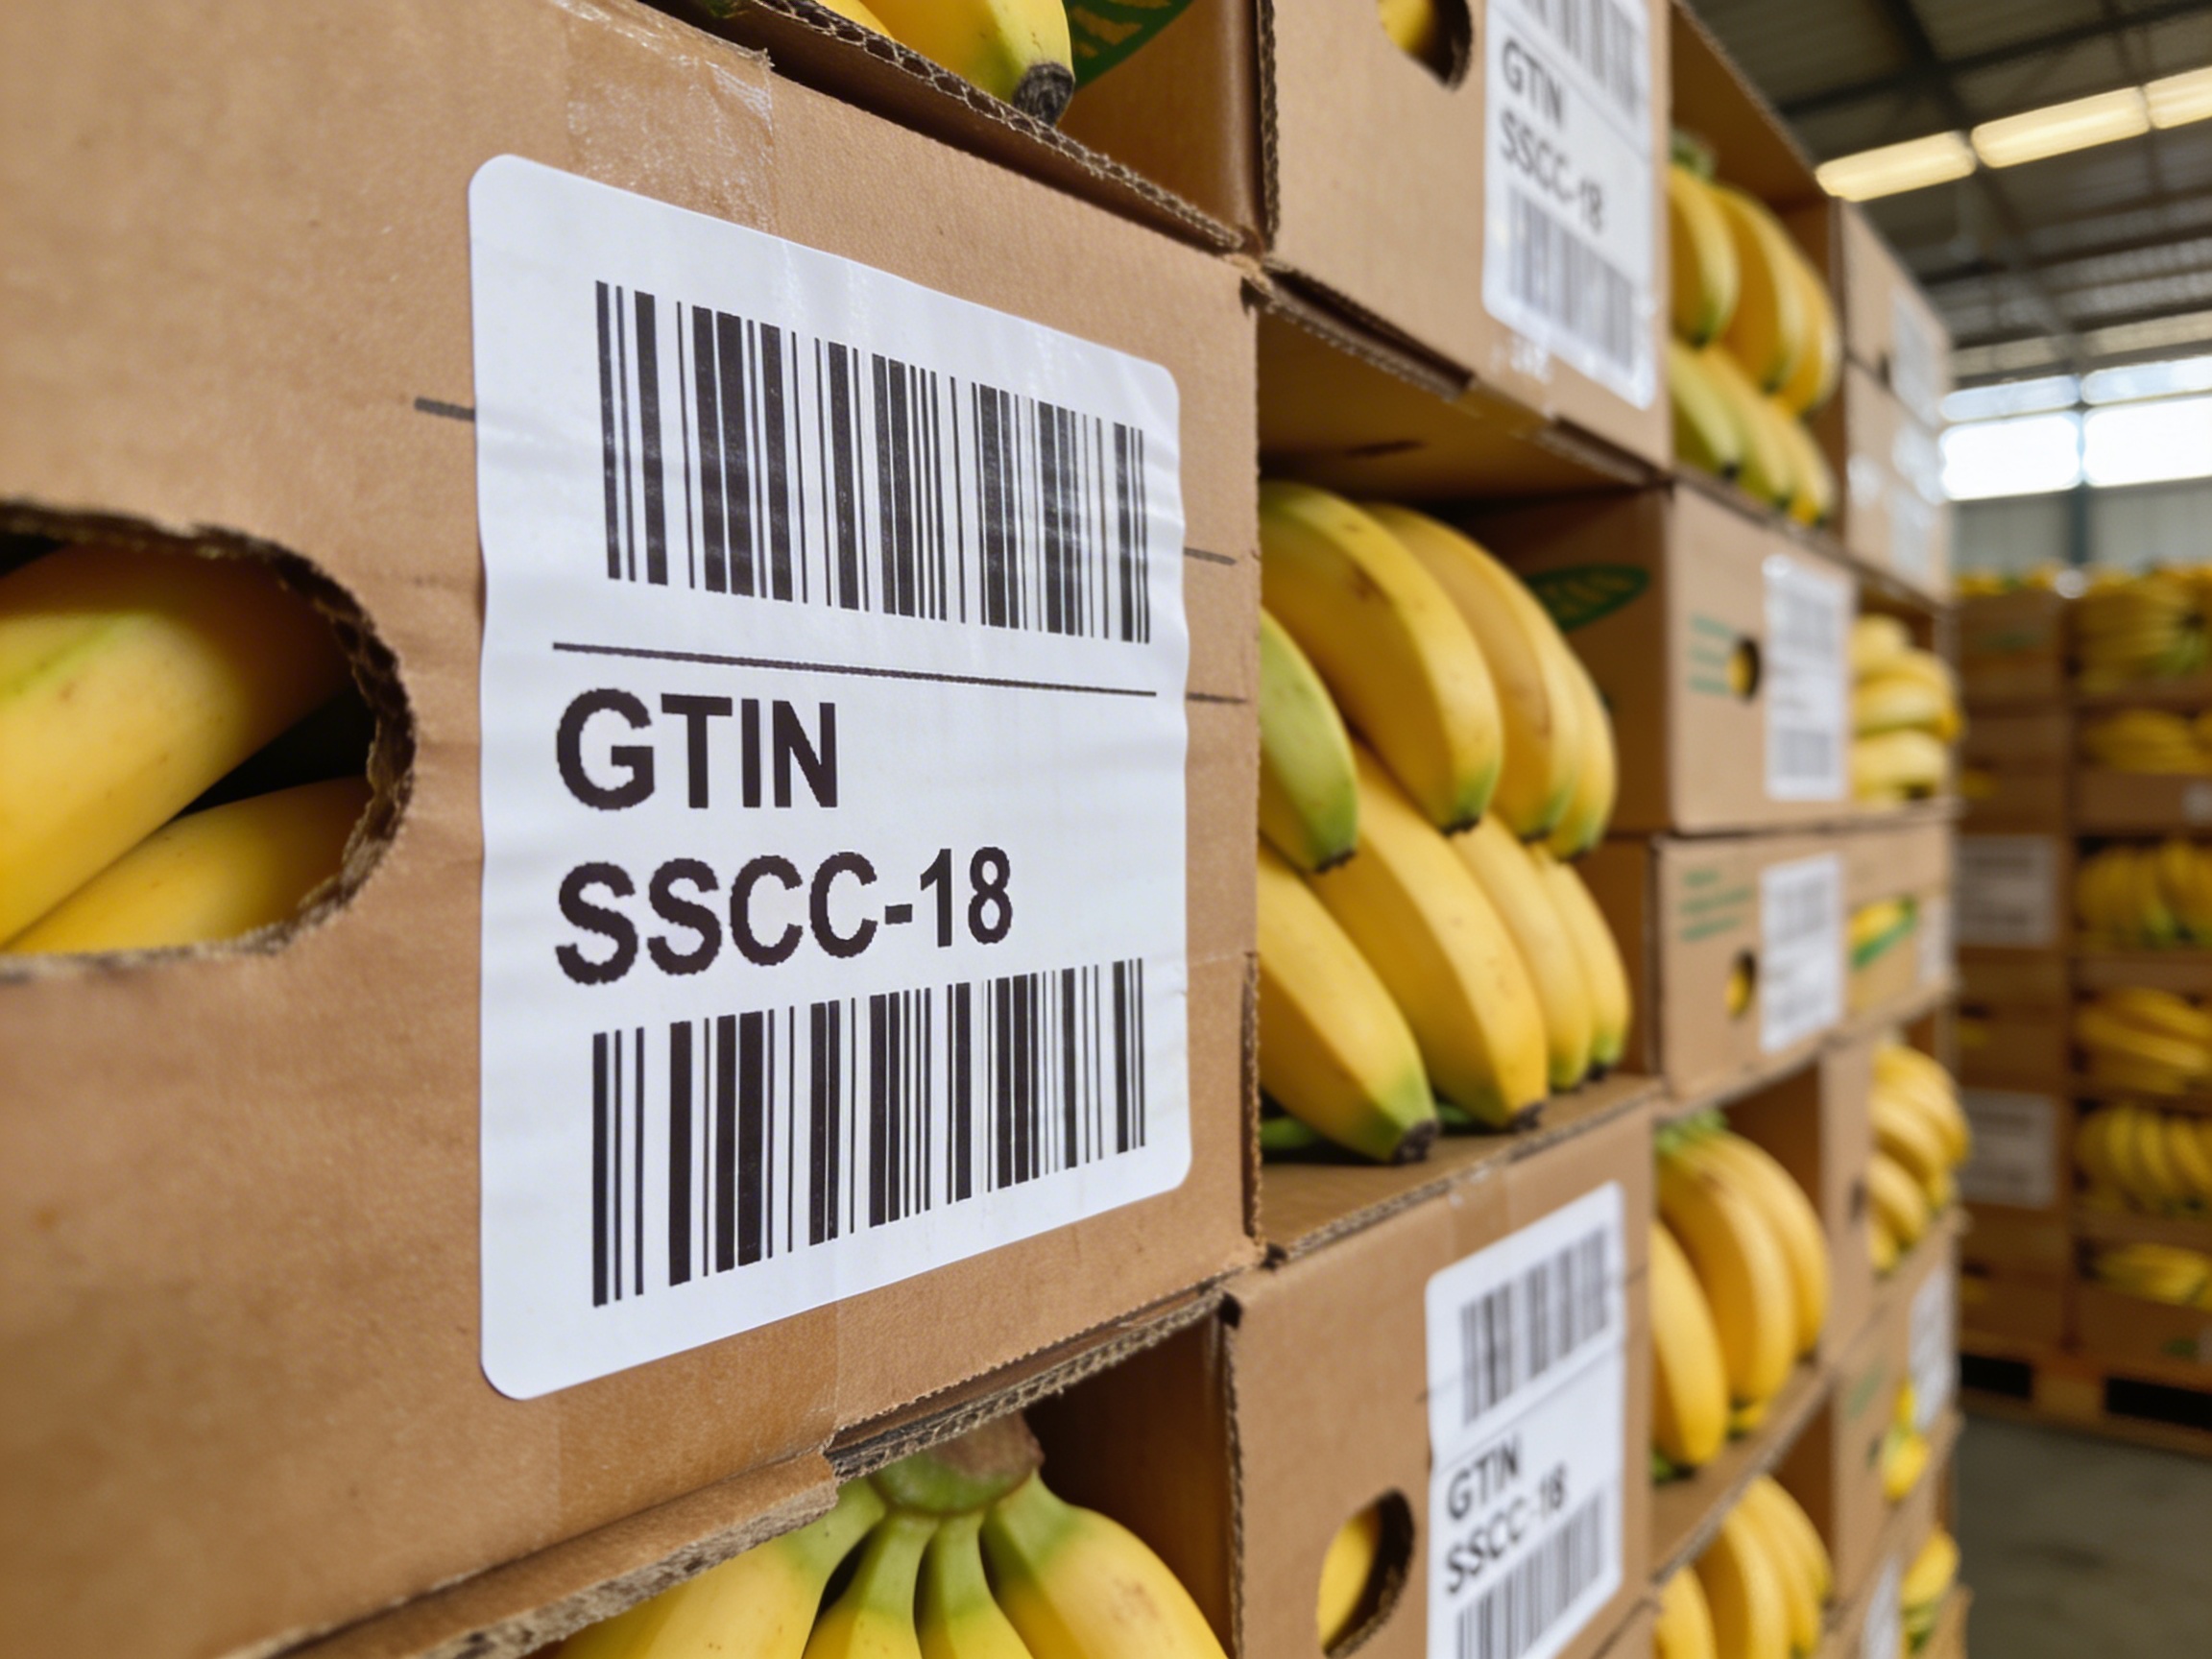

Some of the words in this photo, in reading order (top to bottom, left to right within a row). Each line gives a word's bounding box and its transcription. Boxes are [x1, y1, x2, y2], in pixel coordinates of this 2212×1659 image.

[556, 688, 838, 810] GTIN
[555, 846, 1013, 986] SSCC-18
[1445, 1462, 1566, 1594] SSCC-18
[1447, 1434, 1522, 1521] GTIN
